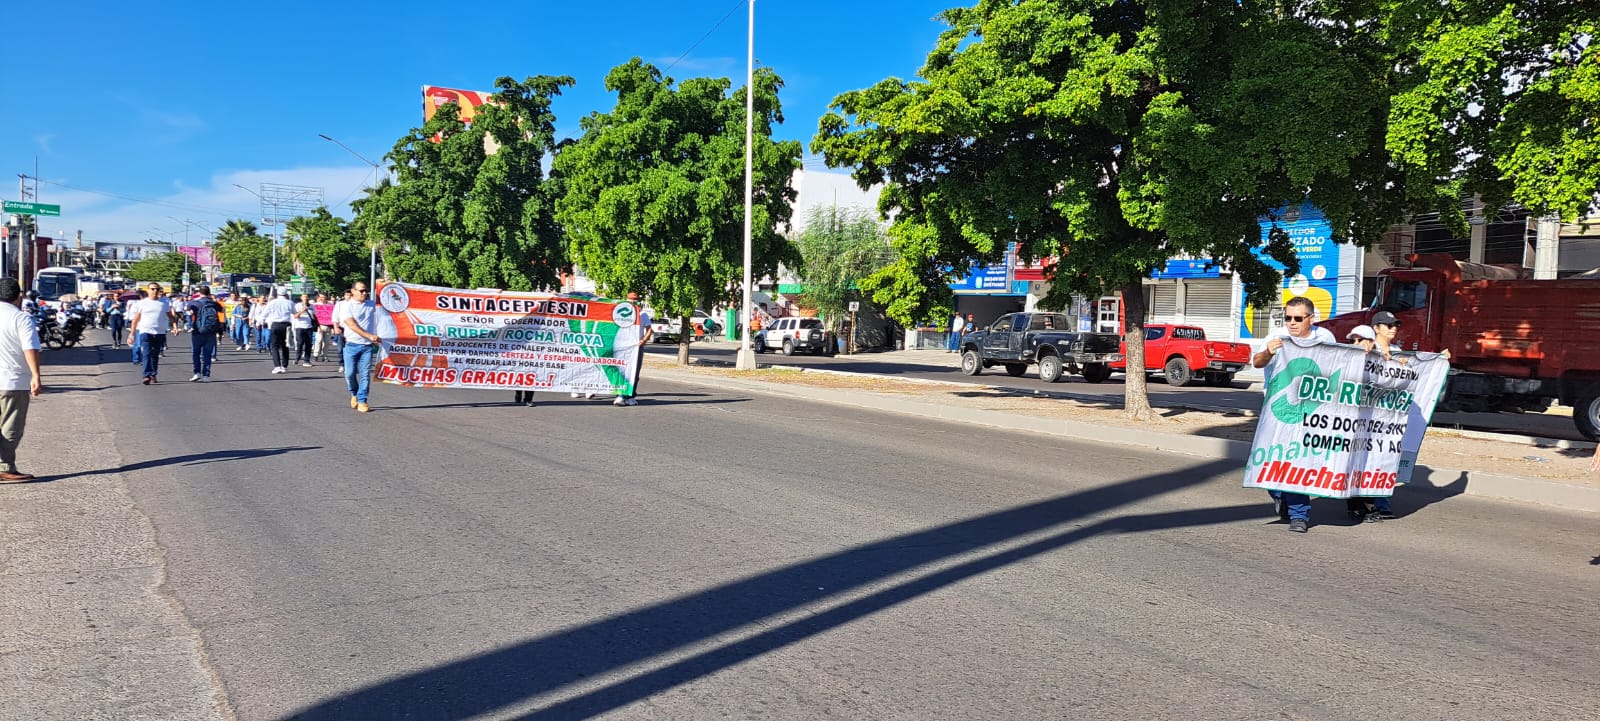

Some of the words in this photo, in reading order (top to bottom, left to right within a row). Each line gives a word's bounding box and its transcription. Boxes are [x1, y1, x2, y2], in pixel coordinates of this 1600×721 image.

[438, 296, 587, 316] SINTACEPTESIN
[460, 315, 494, 324] SEÑOR
[504, 318, 565, 327] GOBERNADOR
[415, 324, 442, 337] DR.
[447, 325, 498, 339] RUBÉN
[505, 329, 554, 342] ROCHA
[563, 333, 603, 346] MOYA
[389, 345, 448, 354] AGRADECEMOS
[544, 355, 591, 363] ESTABILIDAD
[457, 342, 497, 351] DOCENTES
[511, 344, 545, 352] CONALEP
[466, 358, 500, 366] REGULAR
[1364, 360, 1385, 377] EÑOR
[379, 365, 457, 383] MUCHAS
[1299, 376, 1333, 402] DR.
[1376, 389, 1415, 412] ROCH
[1303, 412, 1328, 429] LOS
[1367, 420, 1385, 433] DEL
[1376, 439, 1383, 452] Y
